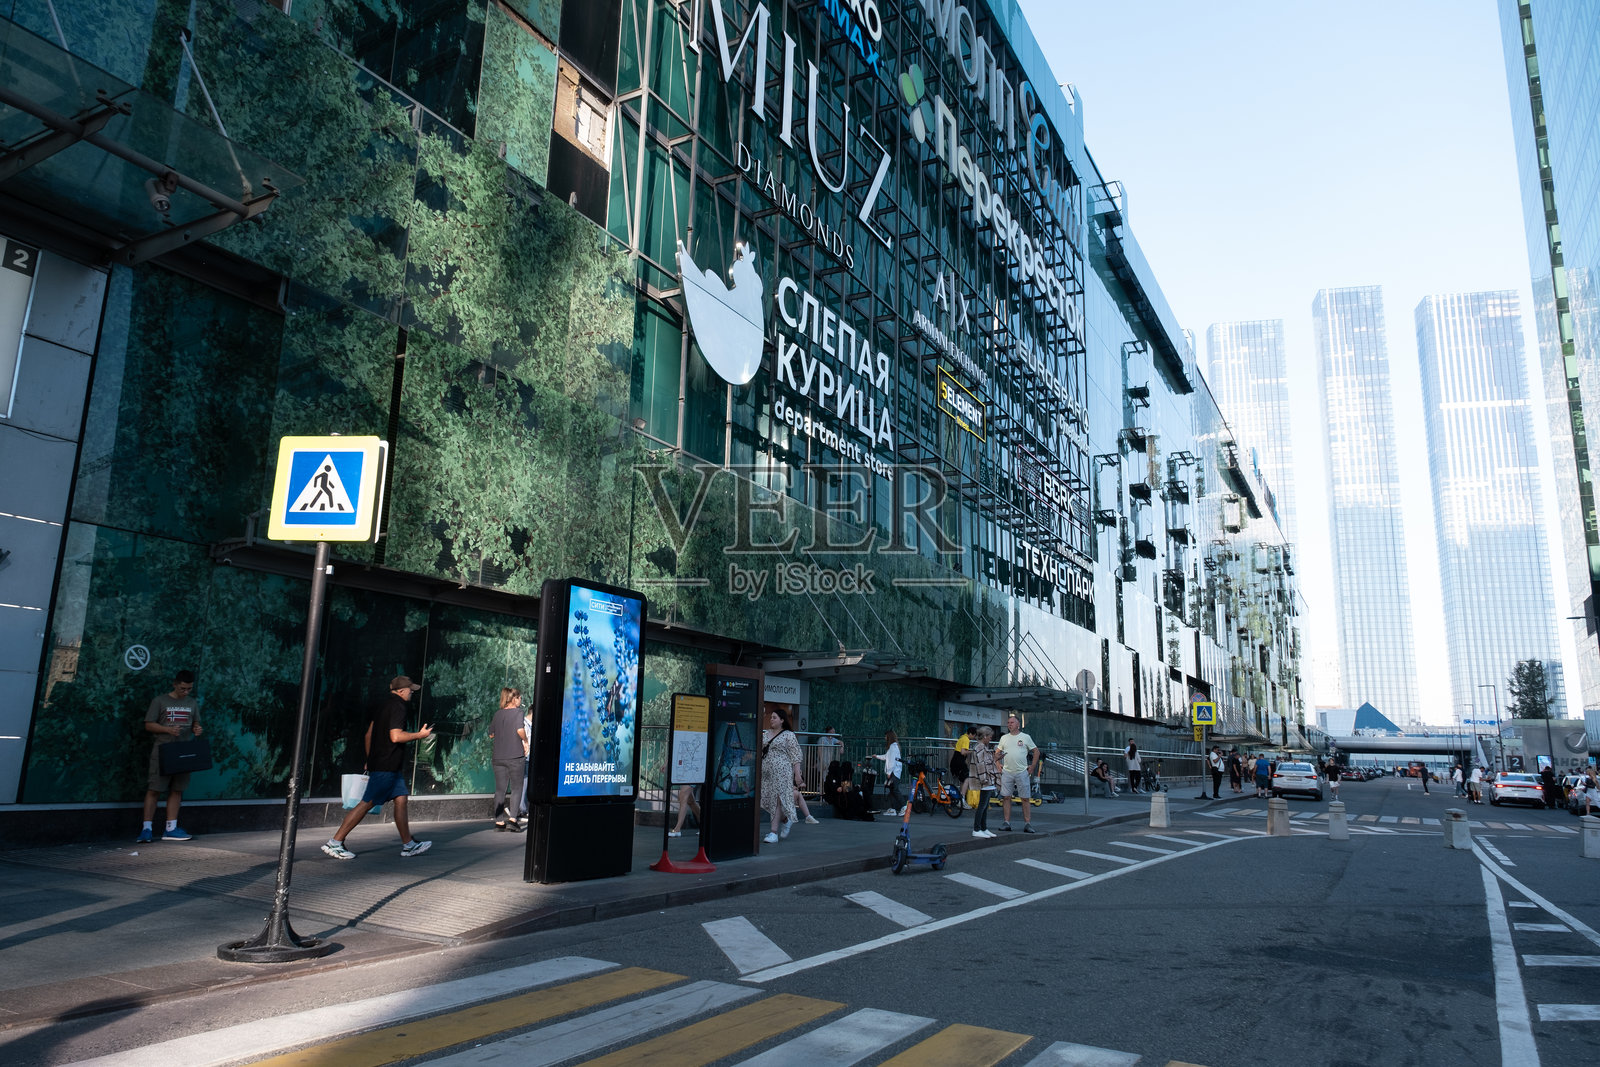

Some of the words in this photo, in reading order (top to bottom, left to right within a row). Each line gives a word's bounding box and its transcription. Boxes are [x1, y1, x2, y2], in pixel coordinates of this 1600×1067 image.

[737, 141, 854, 269] DIAMONDS
[935, 94, 1086, 350] Перекрёсток
[13, 249, 29, 269] 2
[778, 276, 889, 396] СЛЕПАЯ
[912, 309, 948, 351] ARMANI
[950, 340, 989, 388] EXCHANGE
[777, 332, 894, 452] КУРИЦА
[1017, 338, 1081, 422] EUROSPAR
[774, 395, 861, 463] department
[864, 450, 894, 482] store
[1043, 471, 1075, 515] BORK
[1021, 539, 1095, 607] ТЕХНОПАРК
[563, 774, 591, 785] ДЕЛАТЬ
[592, 774, 627, 784] ПЕРЕРЫВЫ
[564, 762, 575, 772] НЕ
[575, 761, 615, 772] ЗАБЫВАЙТЕ
[1512, 757, 1520, 767] 2
